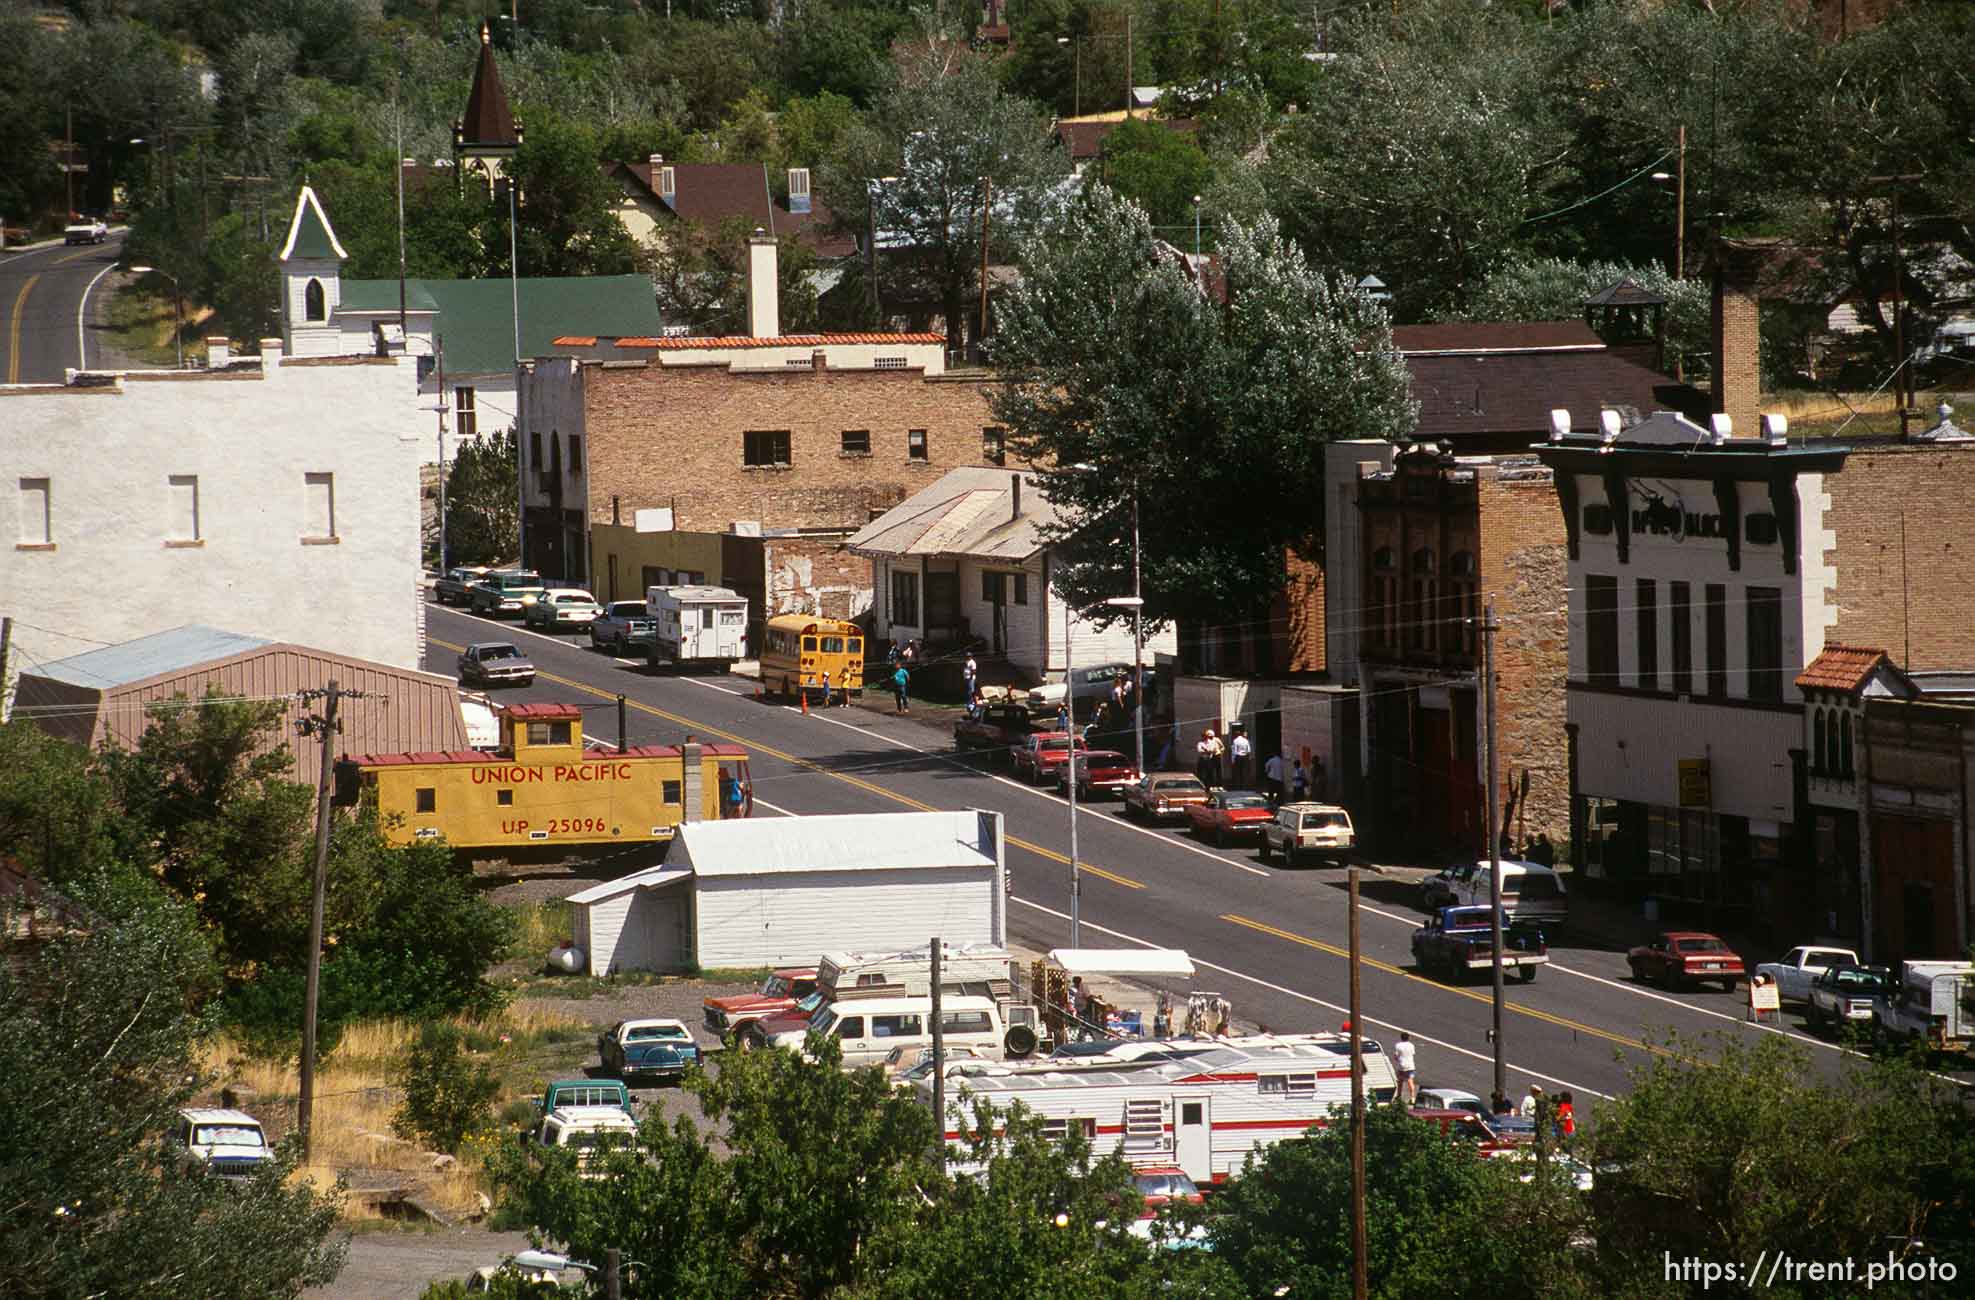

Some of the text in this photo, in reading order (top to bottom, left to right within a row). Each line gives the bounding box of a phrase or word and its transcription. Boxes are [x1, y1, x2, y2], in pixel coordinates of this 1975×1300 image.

[471, 763, 632, 785] UNION PACIFIC
[548, 817, 606, 834] 25096
